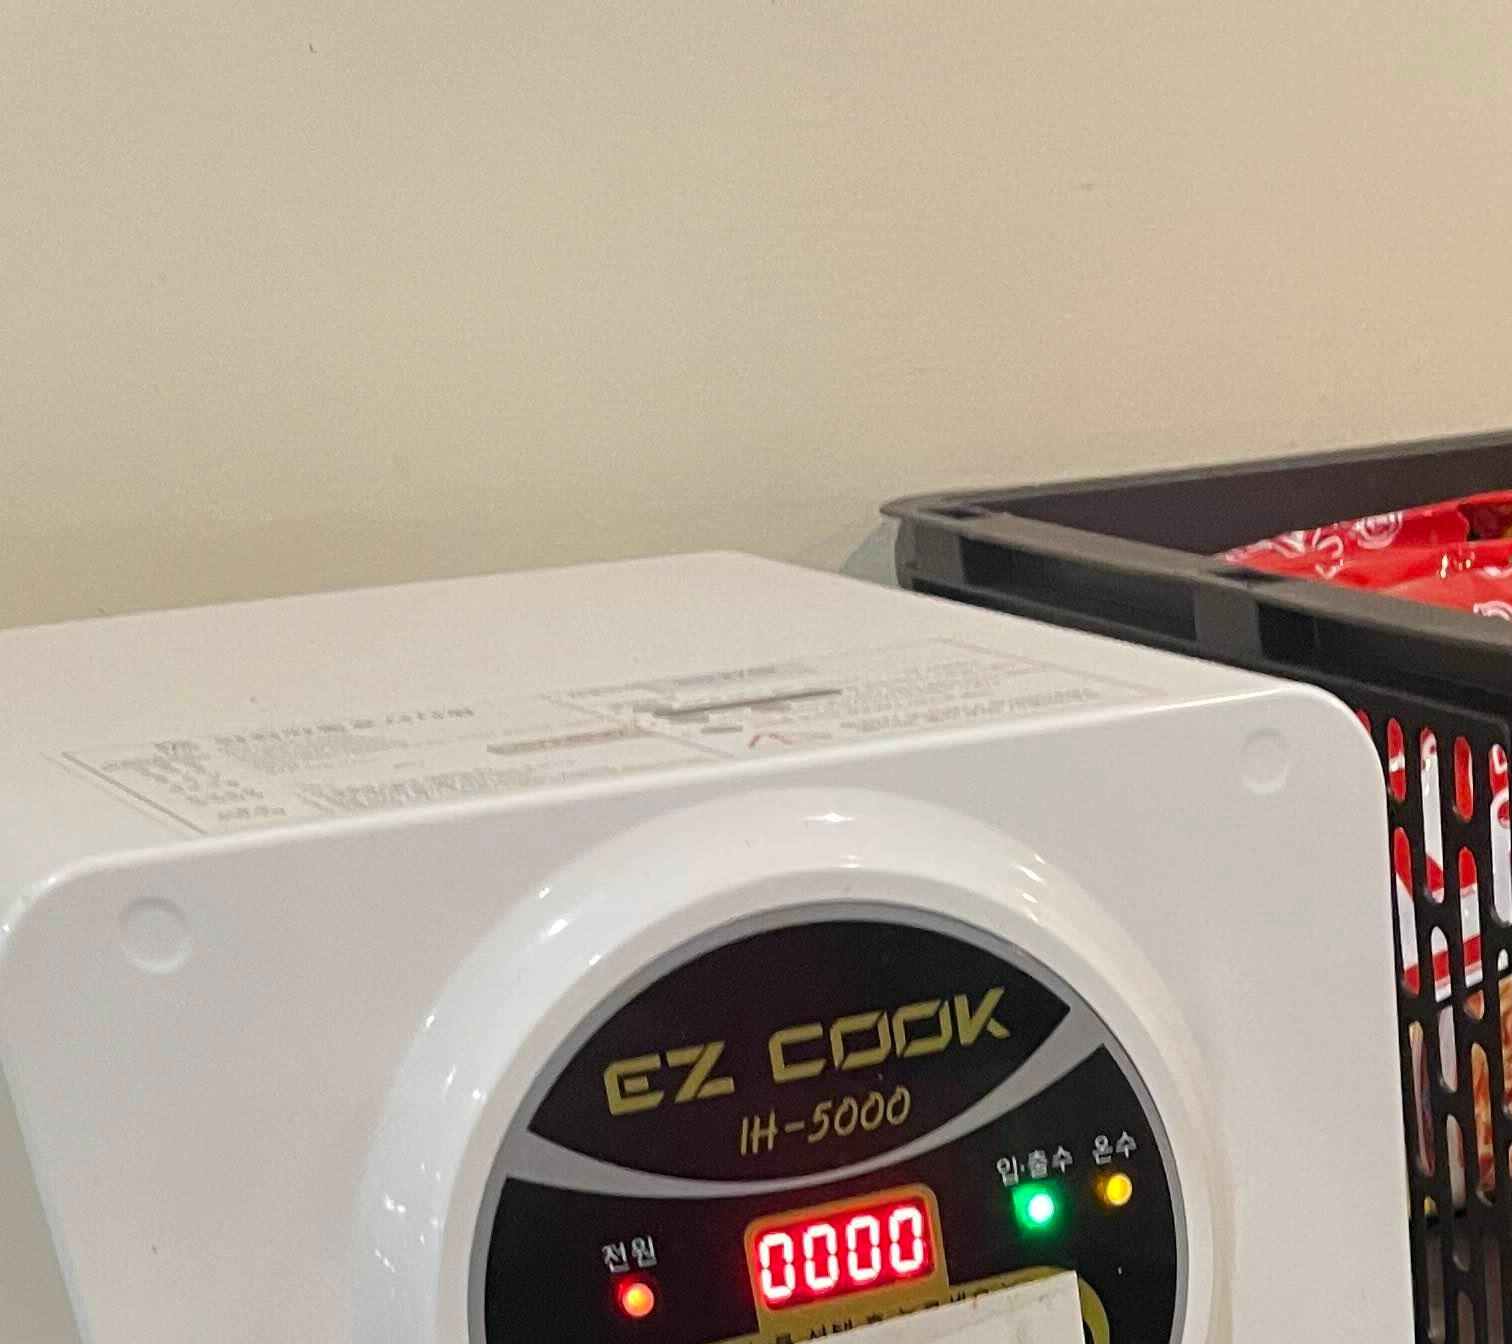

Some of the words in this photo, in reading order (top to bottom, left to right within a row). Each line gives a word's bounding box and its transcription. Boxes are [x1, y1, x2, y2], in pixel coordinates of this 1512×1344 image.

[602, 1043, 735, 1117] EZ
[767, 985, 1010, 1083] COOK
[738, 1087, 912, 1157] IH-5000
[602, 1235, 657, 1270] 전원
[755, 1205, 927, 1305] 0000
